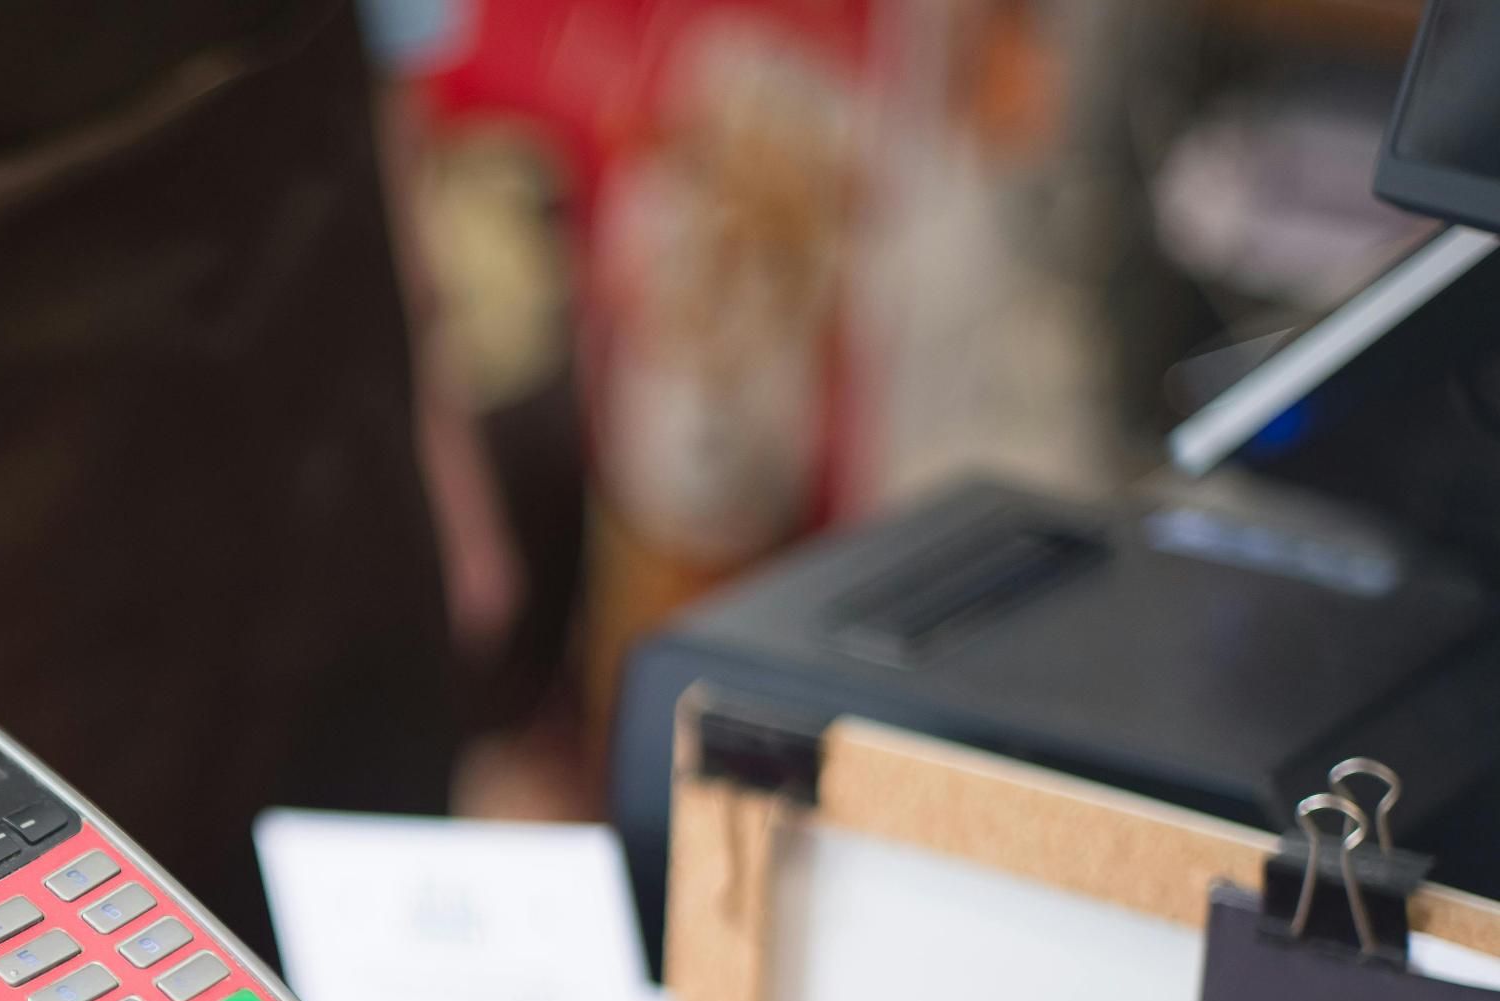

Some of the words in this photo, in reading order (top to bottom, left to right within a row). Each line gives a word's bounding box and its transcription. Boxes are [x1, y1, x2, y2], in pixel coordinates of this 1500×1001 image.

[66, 870, 88, 886] 3
[101, 903, 122, 919] 6
[139, 937, 160, 953] 9
[17, 950, 39, 967] 5
[56, 985, 78, 1001] 8
